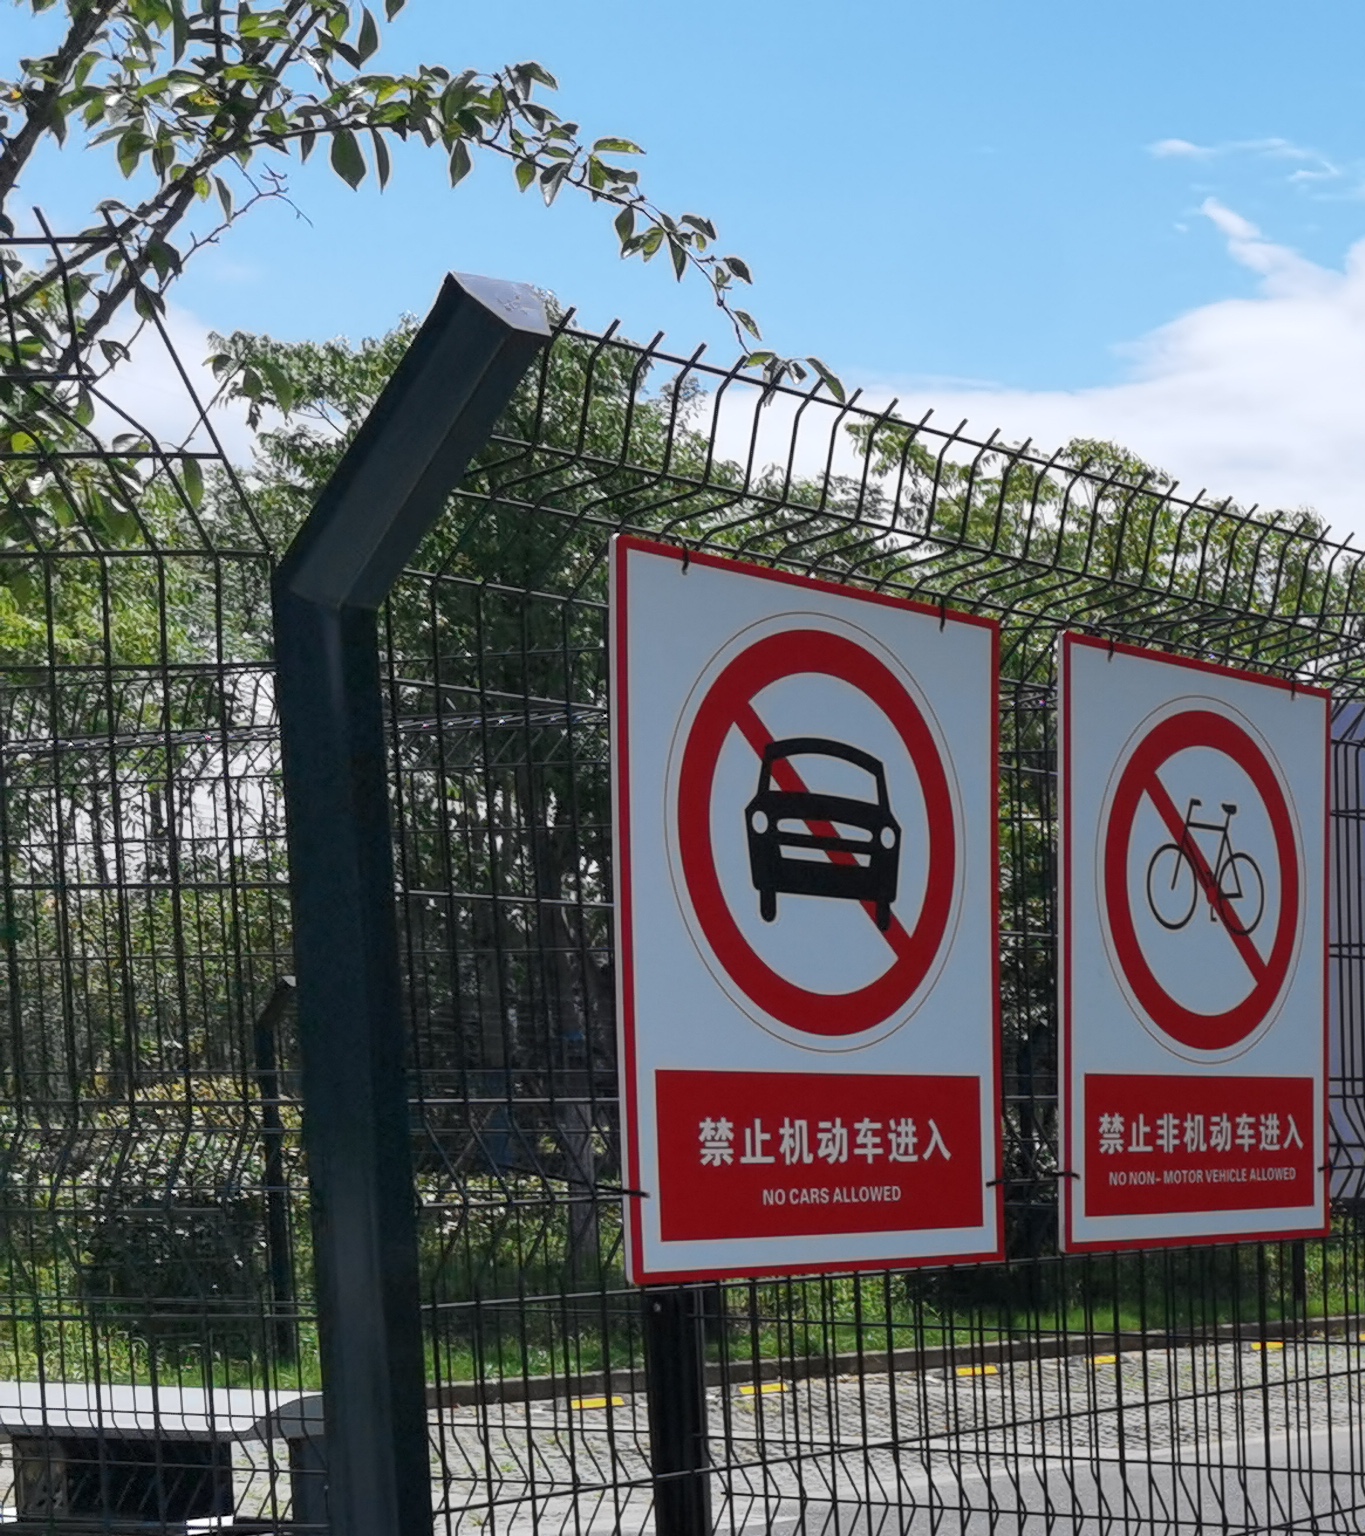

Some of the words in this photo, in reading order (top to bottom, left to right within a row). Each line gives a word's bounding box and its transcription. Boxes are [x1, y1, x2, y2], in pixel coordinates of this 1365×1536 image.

[698, 1117, 952, 1167] 禁止机动车进入
[1098, 1112, 1304, 1155] 禁止非机动车进入
[1109, 1171, 1127, 1186] NO
[1163, 1169, 1203, 1185] MOTOR
[1205, 1168, 1247, 1184] VEHICLE
[1249, 1166, 1297, 1182] ALLOWED
[762, 1188, 786, 1206] NO
[789, 1187, 830, 1205] CARS
[833, 1185, 902, 1203] ALLOWED
